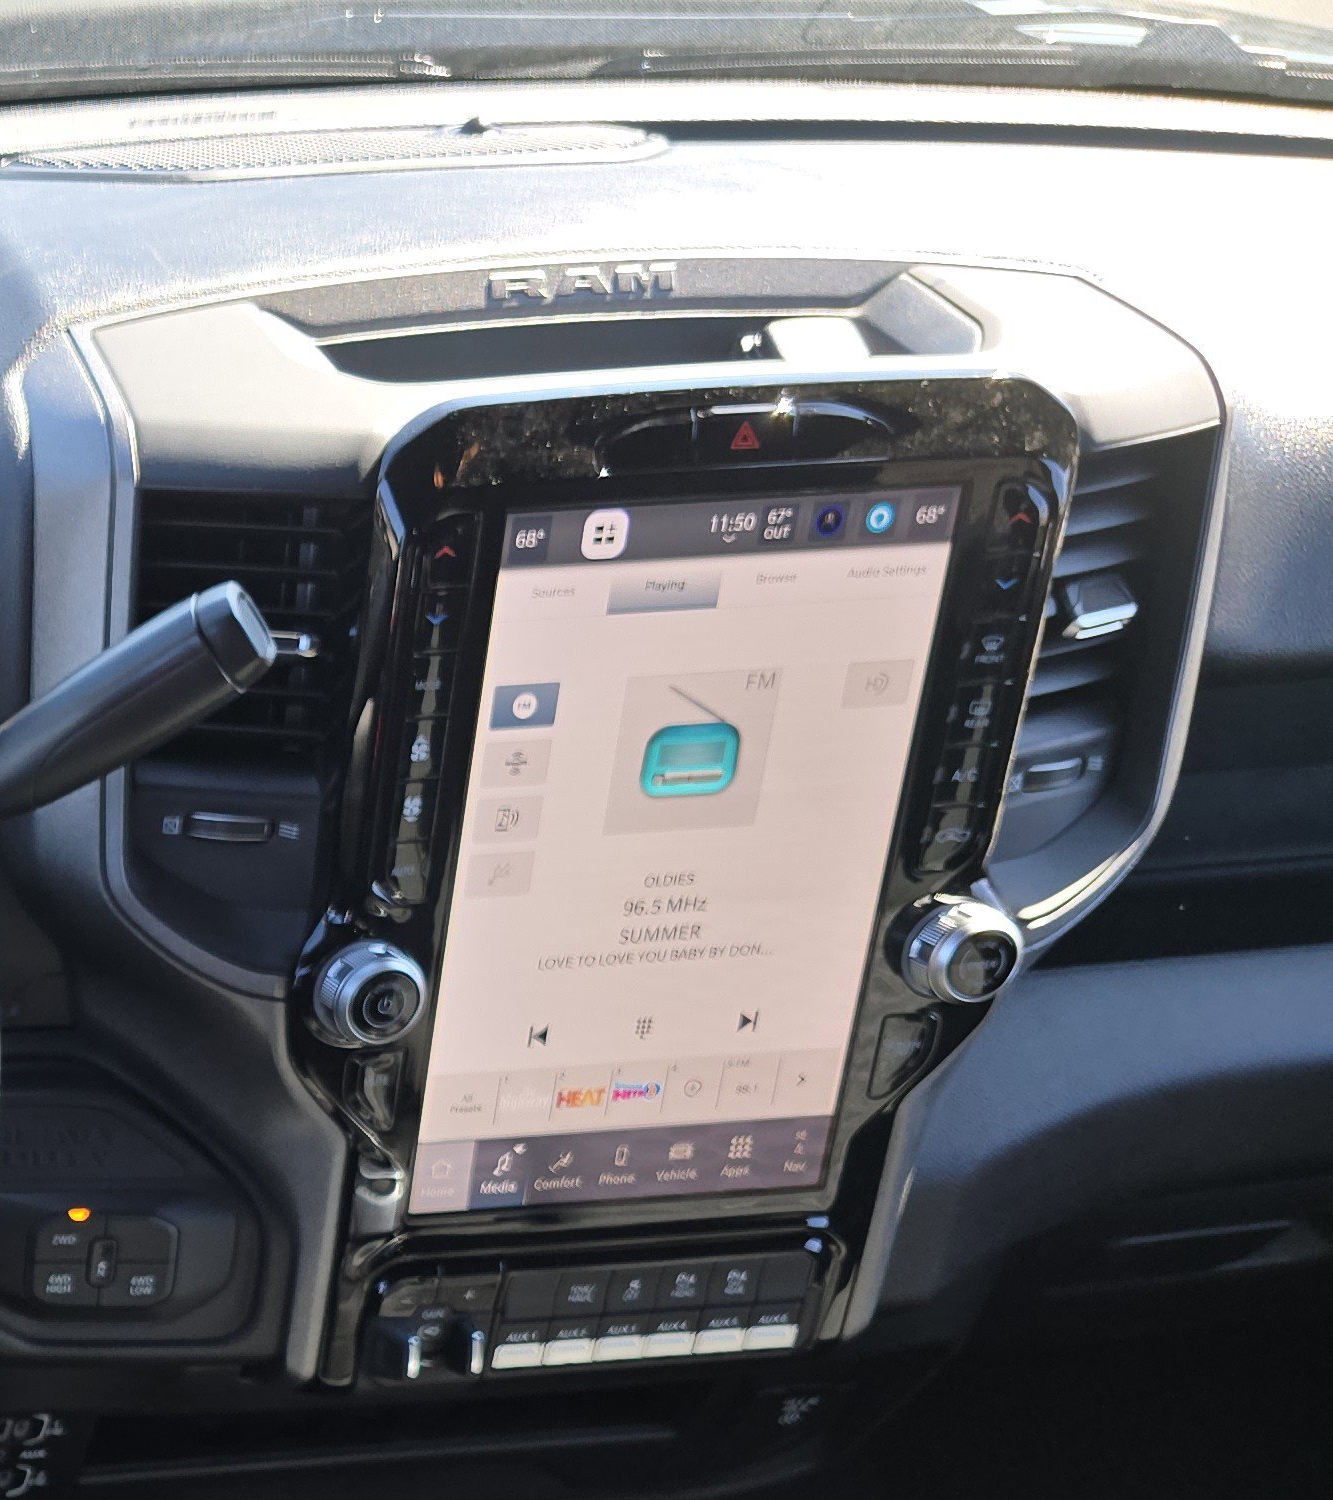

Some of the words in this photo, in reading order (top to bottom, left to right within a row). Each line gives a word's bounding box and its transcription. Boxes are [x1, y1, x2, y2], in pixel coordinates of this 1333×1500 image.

[485, 261, 677, 307] RAM
[710, 511, 757, 535] 11:50
[763, 525, 792, 541] OUT
[755, 570, 797, 585] Browse
[846, 566, 881, 580] Audio
[883, 563, 928, 580] Settings
[531, 585, 576, 600] Sources
[644, 577, 686, 594] Playing
[745, 673, 777, 691] FM
[644, 872, 695, 889] OLDIES
[622, 898, 664, 918] 96.5
[666, 896, 708, 915] MHz
[618, 924, 702, 945] SUMMER
[537, 956, 573, 972] LOVE
[574, 954, 596, 969] TO
[598, 953, 635, 968] LOVE
[637, 950, 668, 966] YOU
[669, 947, 708, 964] BABY
[708, 946, 727, 961] BY
[556, 1086, 606, 1108] HEAT
[719, 1163, 750, 1179] Apps
[783, 1160, 806, 1174] Nav
[598, 1171, 635, 1186] Phone
[655, 1168, 698, 1182] Vehicle
[480, 1180, 516, 1195] Media
[534, 1175, 583, 1191] Comfort
[51, 1233, 77, 1246] 2WD
[48, 1273, 72, 1285] 4WD
[130, 1275, 154, 1286] 4WD
[129, 1285, 153, 1297] LOW
[657, 1321, 679, 1332] AUX
[709, 1317, 730, 1328] AUX
[759, 1314, 779, 1325] AUX
[506, 1331, 529, 1343] AUX
[557, 1328, 578, 1339] AUX
[607, 1324, 628, 1335] AUX
